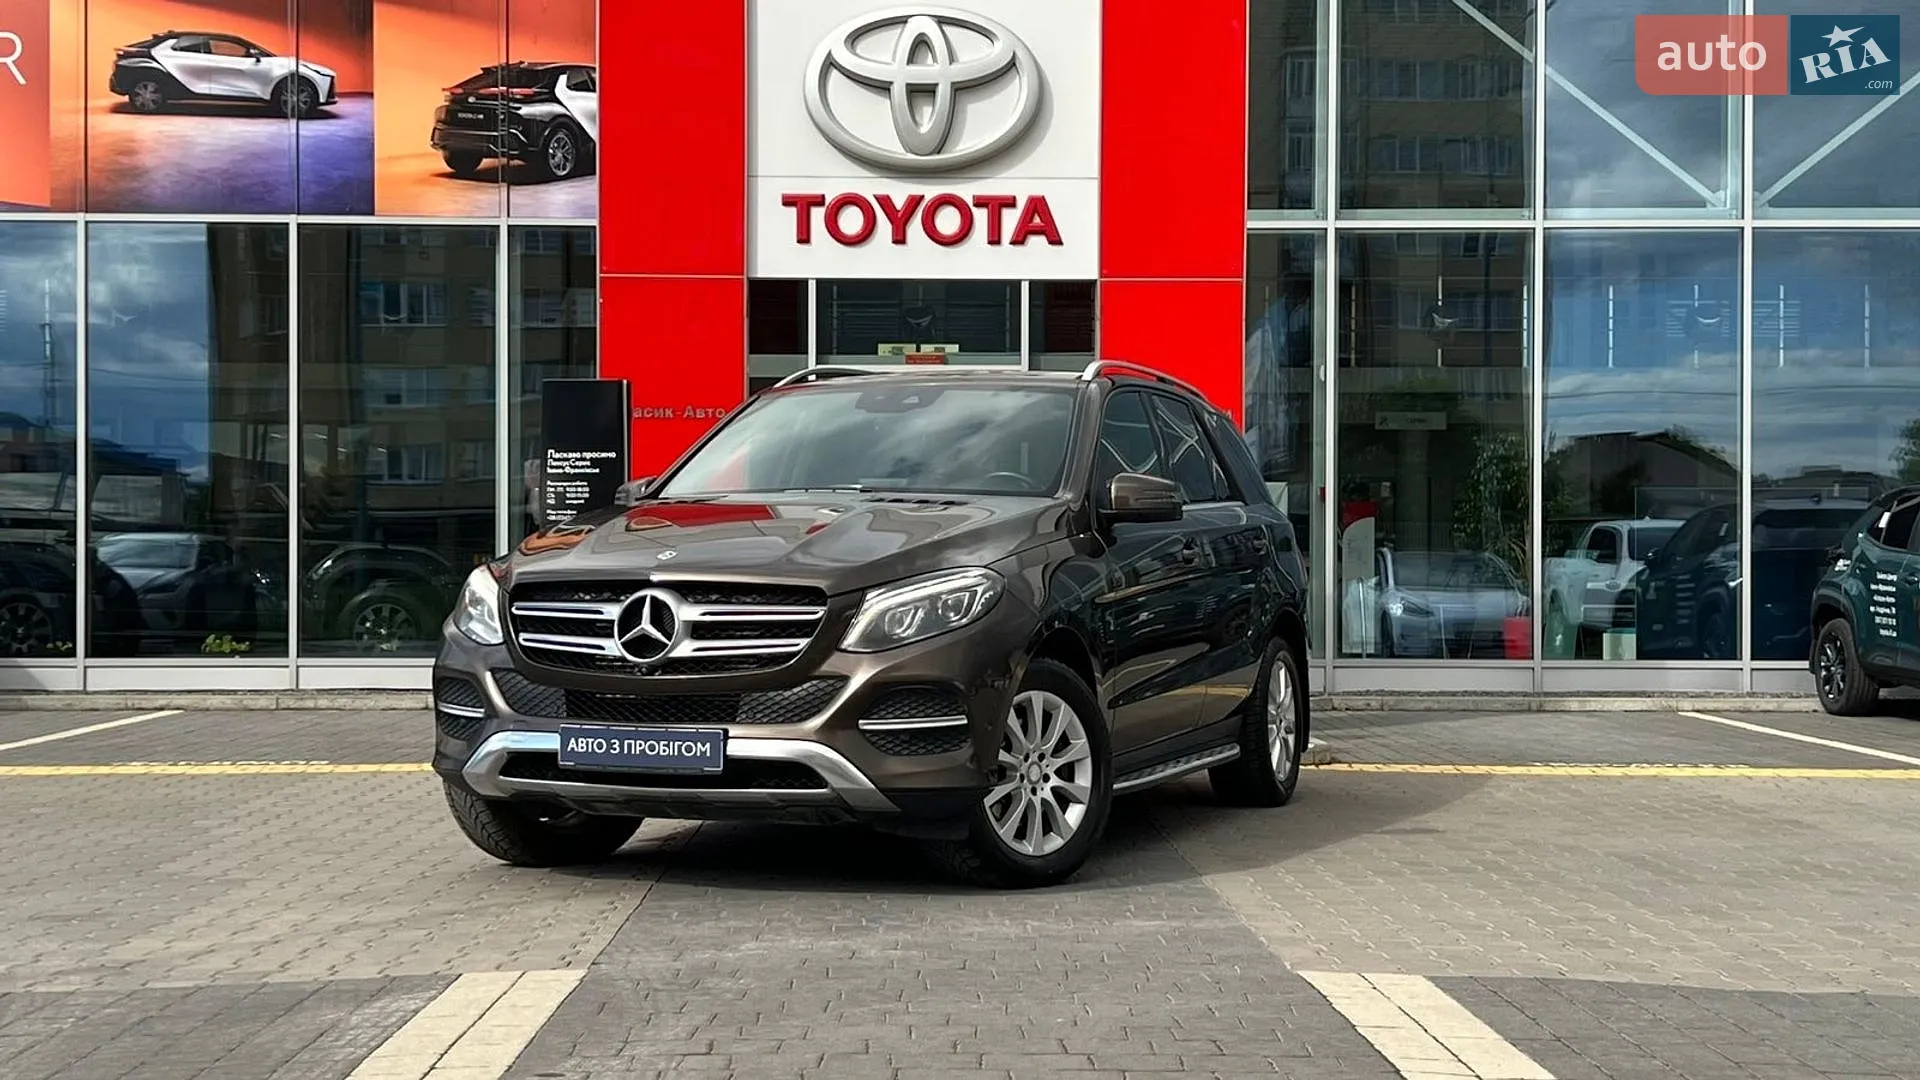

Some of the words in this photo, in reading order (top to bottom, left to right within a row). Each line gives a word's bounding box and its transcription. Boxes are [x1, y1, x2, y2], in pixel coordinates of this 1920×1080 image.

[782, 192, 1064, 247] TOYOTA
[567, 737, 607, 753] АВТО
[610, 740, 620, 754] З
[624, 739, 711, 757] ПРОБІГОМ
